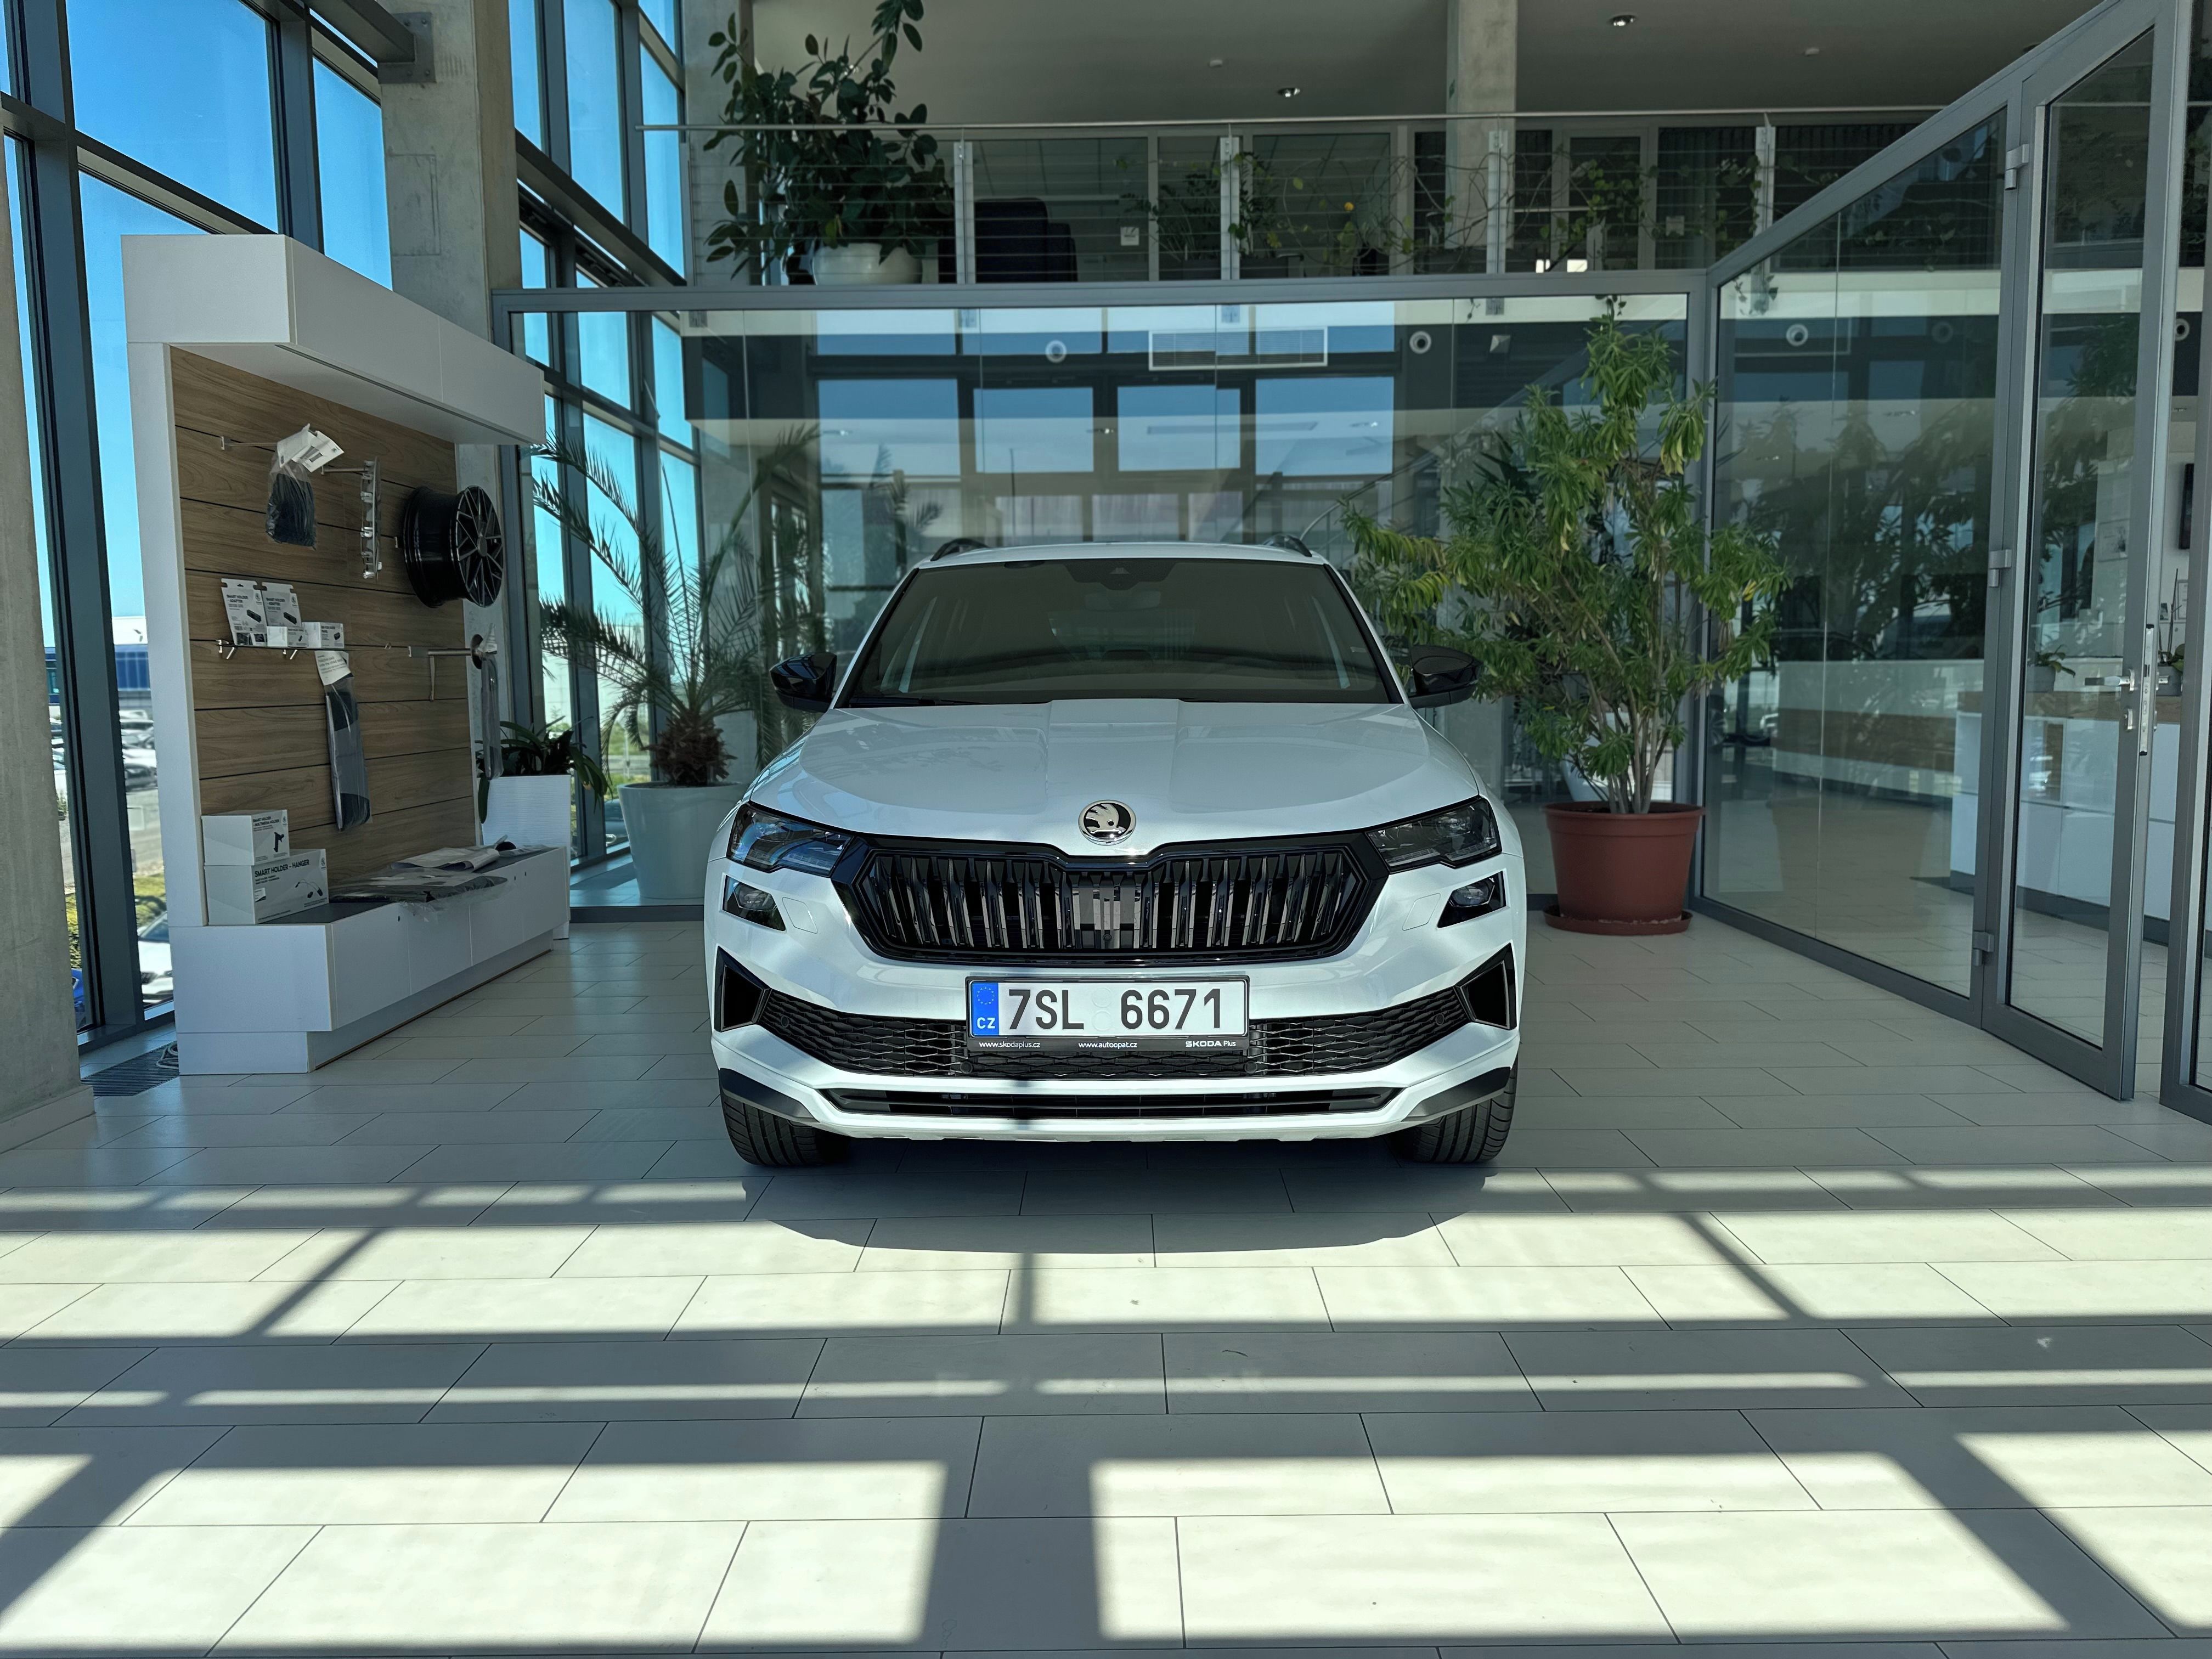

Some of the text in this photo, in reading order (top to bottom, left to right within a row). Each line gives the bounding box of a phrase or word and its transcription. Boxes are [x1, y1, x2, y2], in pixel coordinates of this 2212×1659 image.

[255, 868, 270, 877] SMART
[271, 864, 289, 873] HOLDER
[292, 859, 309, 868] HANGER
[1009, 988, 1221, 1030] 7SL 6671
[977, 1017, 996, 1029] CZ
[979, 1041, 1041, 1049] www.skodaplus.cz
